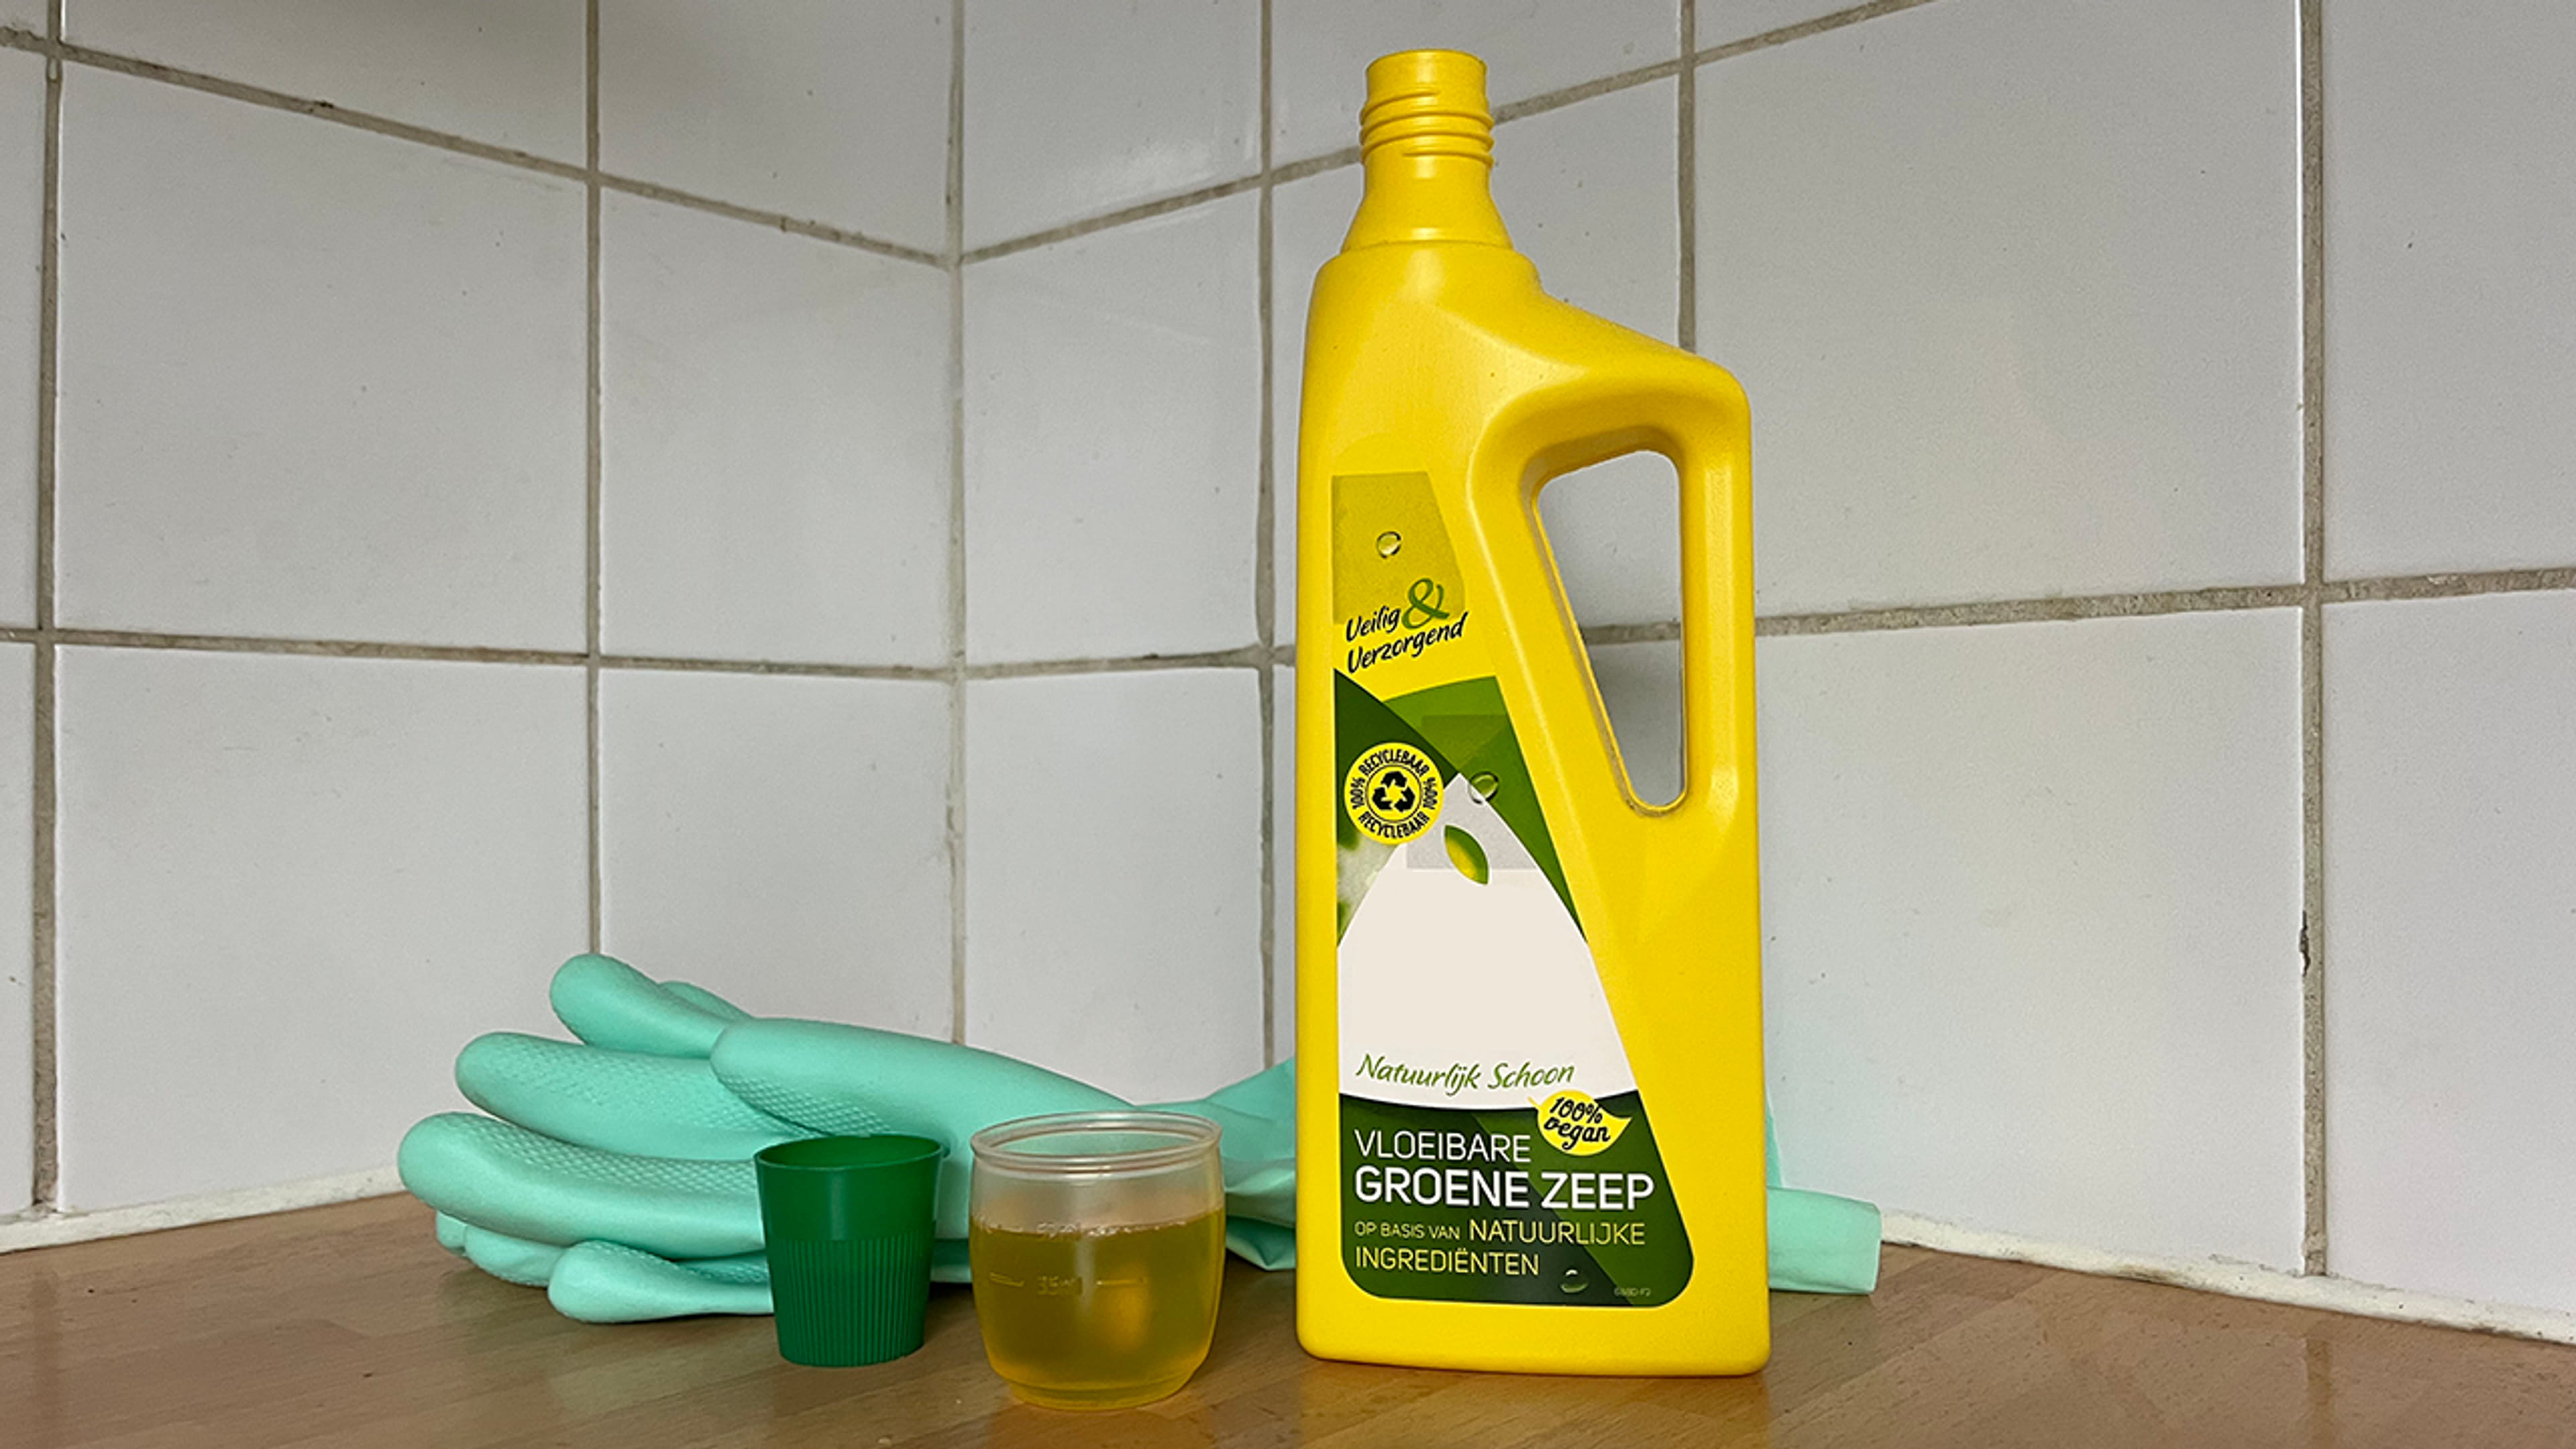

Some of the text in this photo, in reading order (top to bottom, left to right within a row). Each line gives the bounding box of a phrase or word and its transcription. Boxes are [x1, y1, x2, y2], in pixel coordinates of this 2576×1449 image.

[1346, 578, 1450, 642] Veilig &
[1348, 611, 1468, 674] Verzorgend
[1350, 749, 1430, 810] 100% RECYCLEBAAR
[1358, 777, 1438, 839] RECYCLEBAAR 100%
[1356, 1053, 1574, 1097] Natuurlijk Schoon
[1550, 1097, 1603, 1124] 100%
[1354, 1129, 1531, 1163] VLOEIBARE
[1544, 1117, 1611, 1150] vegan
[1355, 1165, 1654, 1210] GROENE ZEEP
[1354, 1219, 1646, 1245] OP BASIS VAN NATUURLIJKE
[1356, 1246, 1539, 1275] INGREDIËNTEN
